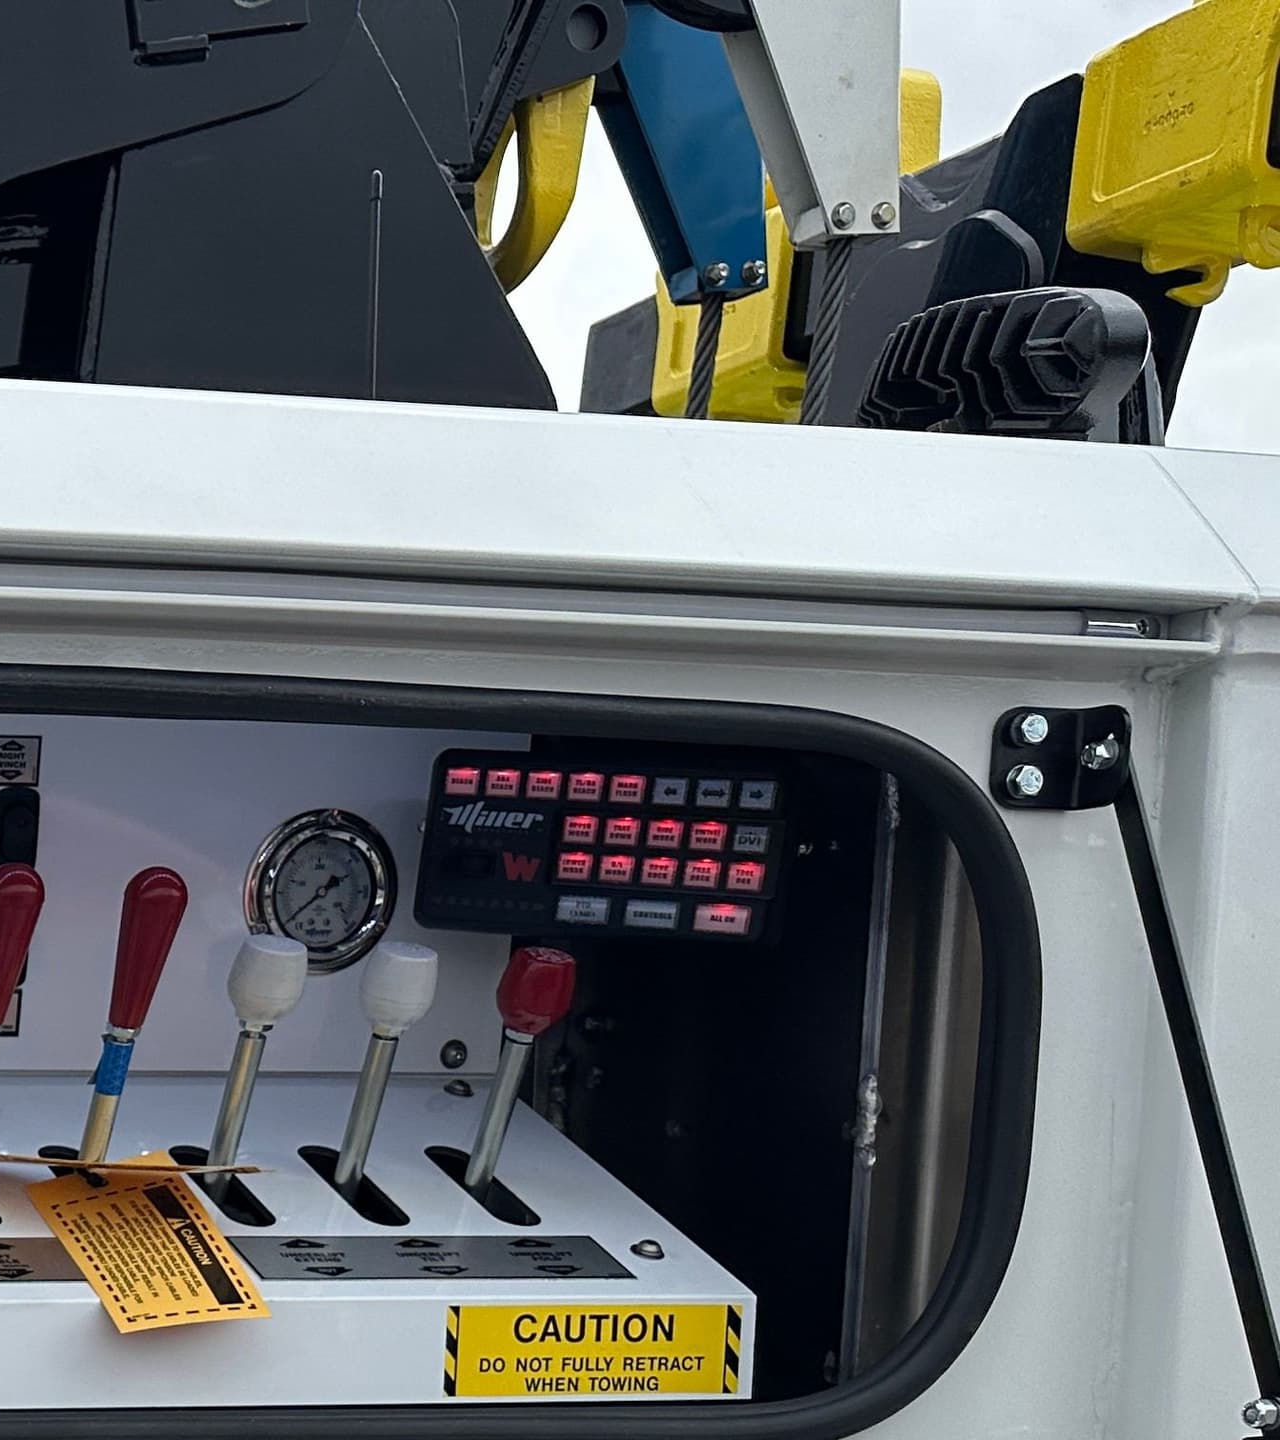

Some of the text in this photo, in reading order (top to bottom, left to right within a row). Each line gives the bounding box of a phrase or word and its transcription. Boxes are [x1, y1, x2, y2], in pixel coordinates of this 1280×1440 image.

[177, 1228, 213, 1265] CAUTION
[513, 1313, 675, 1343] CAUTION
[479, 1356, 705, 1373] DO NOT FULLY RETRACT
[525, 1376, 660, 1392] WHEN TOWING
